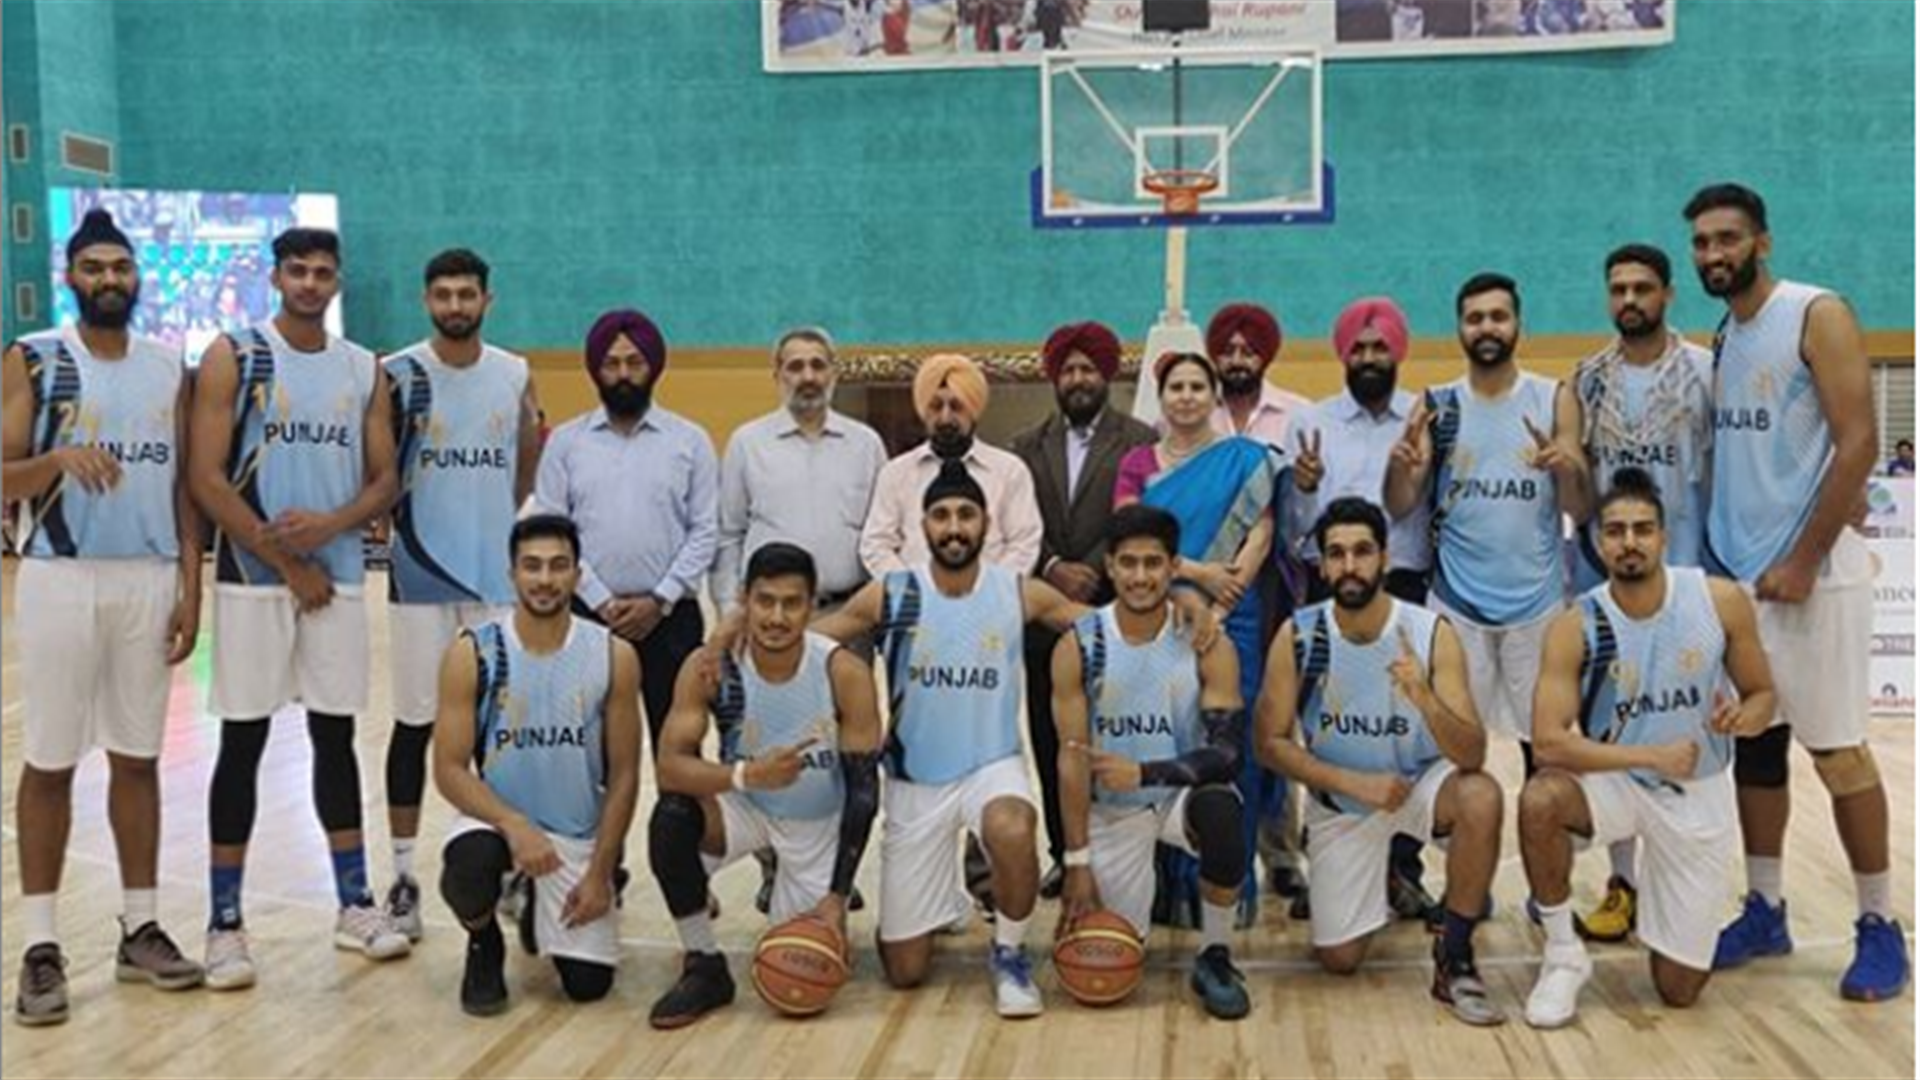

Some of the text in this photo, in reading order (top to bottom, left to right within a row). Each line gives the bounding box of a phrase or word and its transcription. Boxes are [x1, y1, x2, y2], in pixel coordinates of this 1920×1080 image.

[909, 665, 1000, 690] PUNJAB
[1095, 714, 1173, 737] PUNJA
[1319, 713, 1410, 738] PUNJAB
